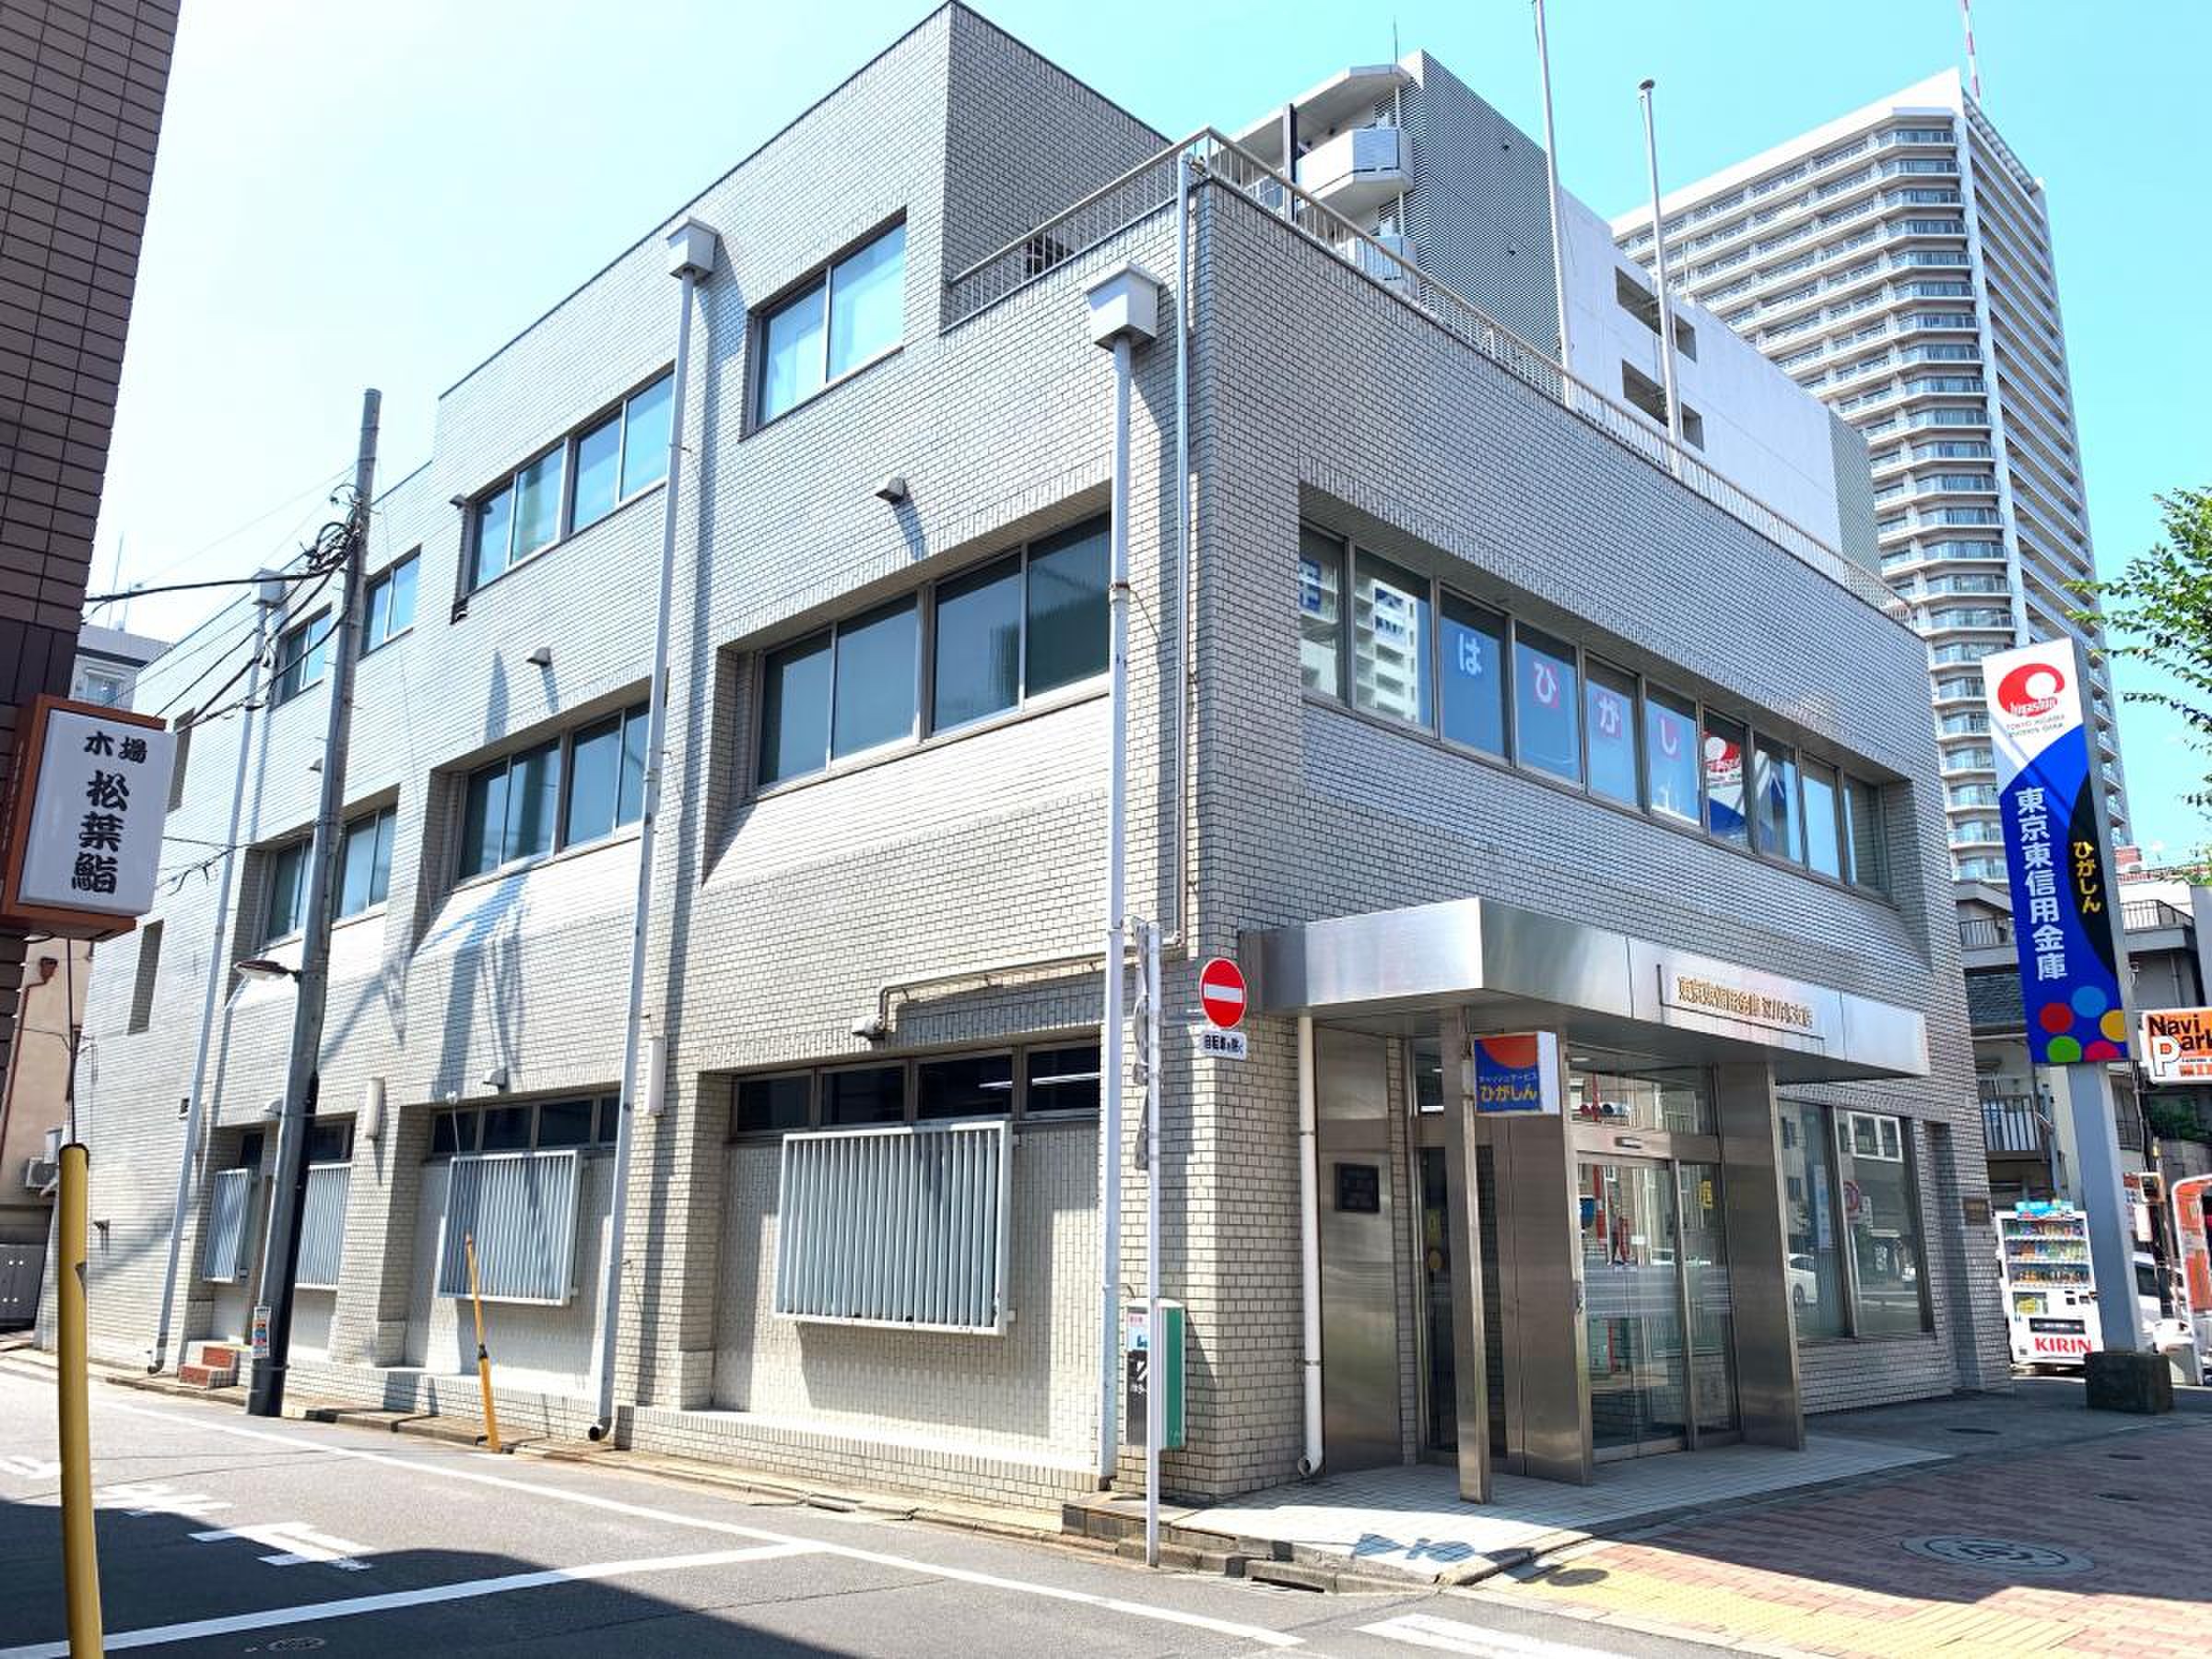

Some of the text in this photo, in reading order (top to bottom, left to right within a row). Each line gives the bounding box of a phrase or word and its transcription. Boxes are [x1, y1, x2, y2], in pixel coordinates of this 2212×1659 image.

[84, 730, 148, 764] 木場
[71, 770, 130, 895] 松葉鮨
[2014, 786, 2068, 982] 東京東信用金庫
[2073, 840, 2102, 914] ひがしん
[2147, 1013, 2201, 1037] Navi
[1478, 1082, 1538, 1103] ひがしん
[2034, 1337, 2093, 1354] KIRIN
